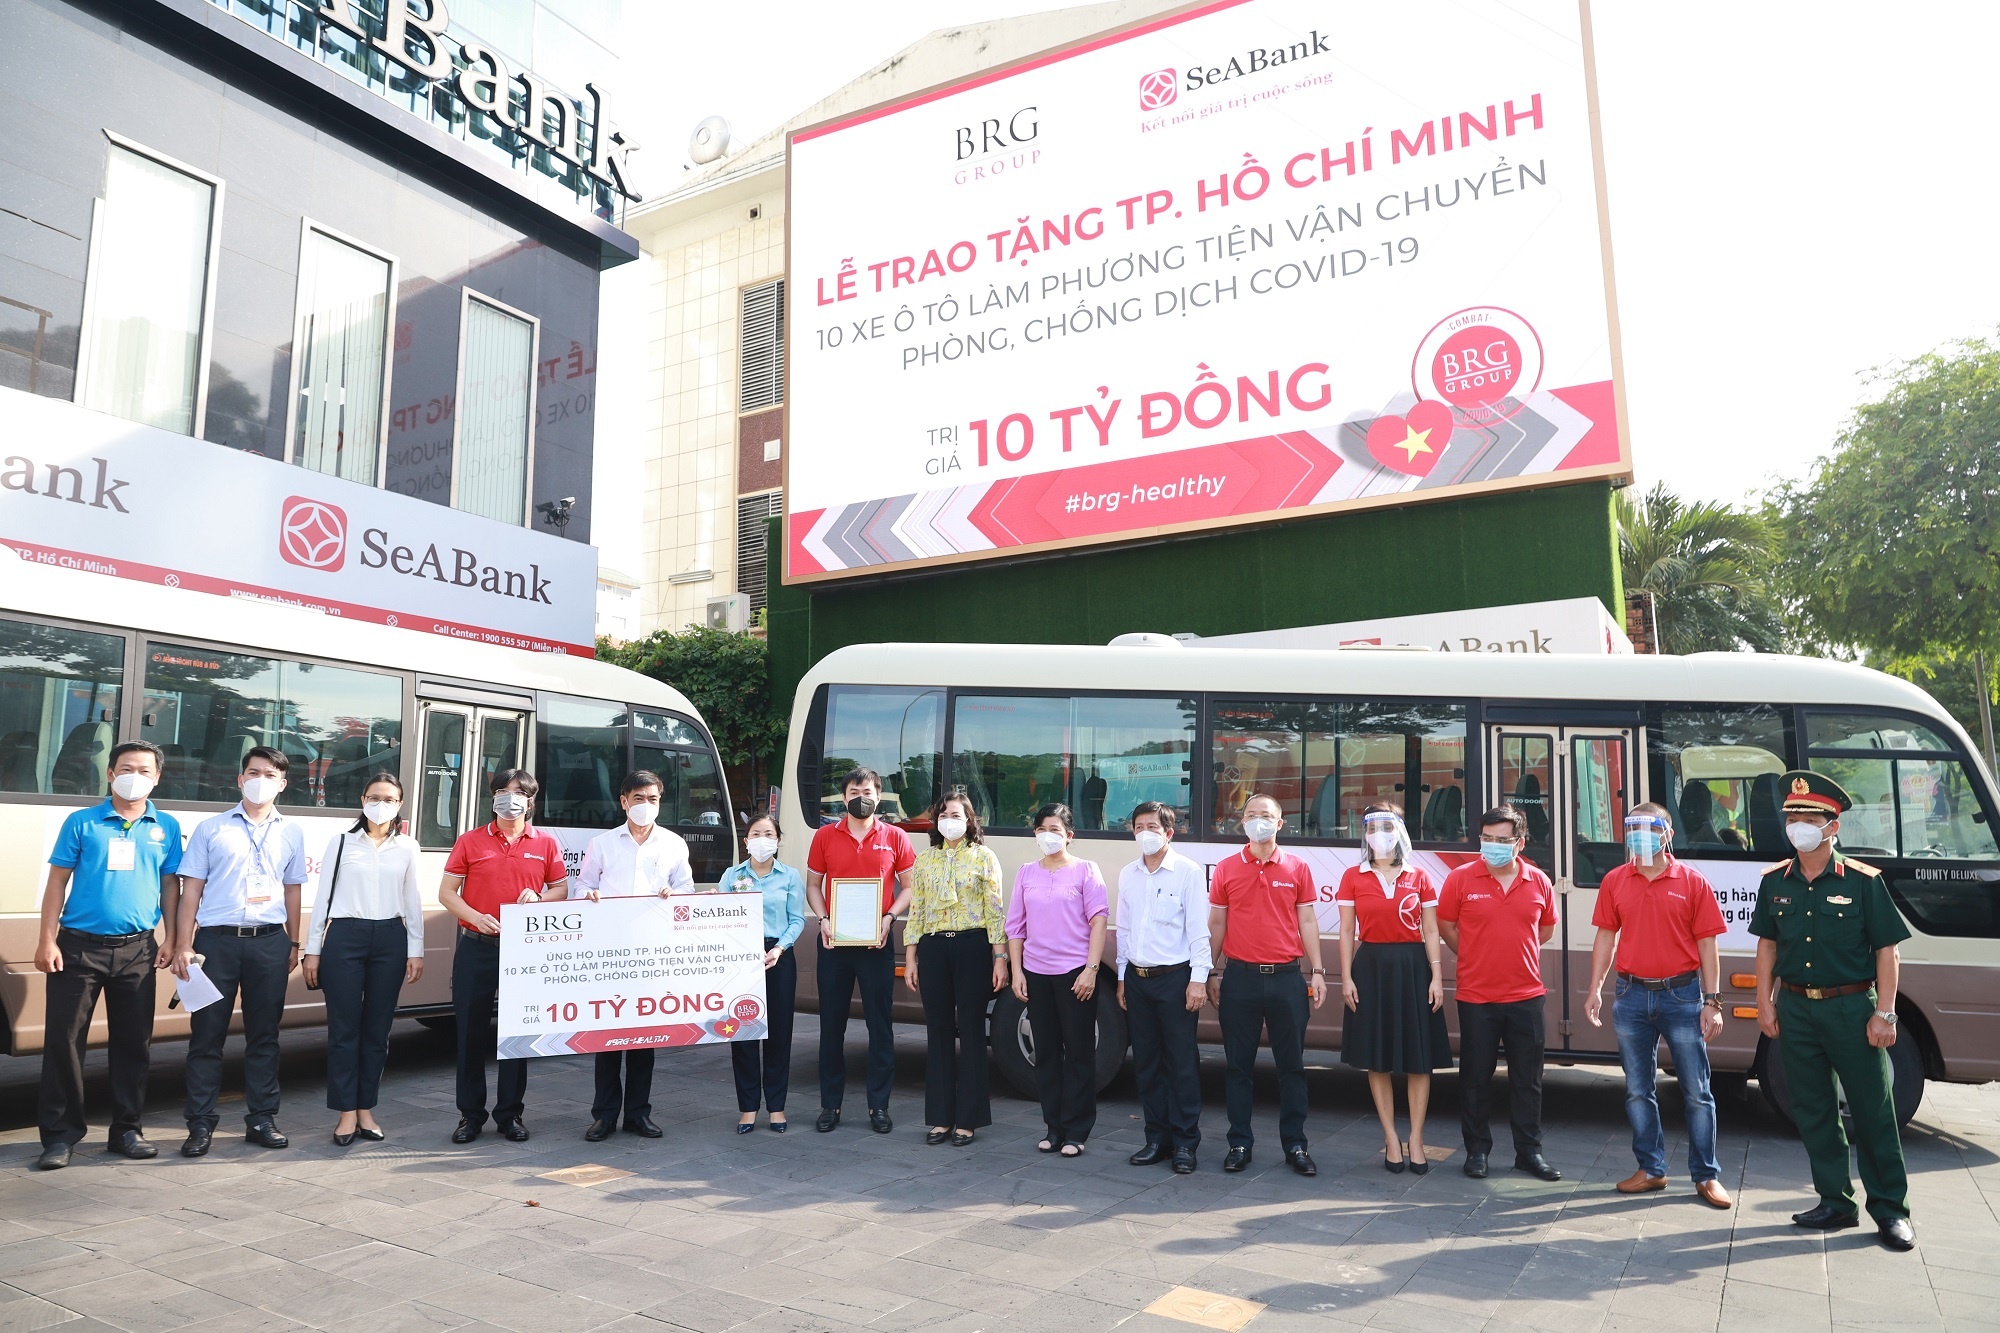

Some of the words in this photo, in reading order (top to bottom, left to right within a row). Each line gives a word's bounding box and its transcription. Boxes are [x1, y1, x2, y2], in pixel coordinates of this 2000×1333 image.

[1186, 30, 1332, 92] SeABank
[1140, 116, 1166, 133] Kết
[1172, 107, 1195, 125] nối
[1200, 101, 1223, 120] giá
[1229, 94, 1247, 109] trị
[1252, 85, 1289, 102] cuộc
[1294, 72, 1333, 91] sống
[955, 106, 1039, 161] BRG
[955, 149, 1041, 185] GROUP
[817, 257, 857, 307] LỄ
[868, 240, 977, 293] TRAO
[987, 207, 1104, 267] TẶNG
[1116, 189, 1182, 231] TP.
[1197, 152, 1270, 213] HỒ
[1284, 127, 1374, 189] CHÍ
[1391, 93, 1544, 165] MINH
[816, 326, 843, 350] 10
[852, 315, 885, 343] XE
[894, 304, 915, 332] Ô
[923, 294, 959, 326] TÔ
[969, 281, 1029, 317] LÀM
[1042, 245, 1185, 300] PHƯƠNG
[1195, 223, 1273, 263] TIỆN
[1285, 202, 1362, 243] VẬN
[1376, 156, 1546, 221] CHUYỂN
[903, 327, 1015, 370] PHÒNG,
[1024, 297, 1142, 343] CHỐNG
[1155, 275, 1237, 318] DỊCH
[1250, 237, 1419, 294] COVID-19
[1441, 340, 1509, 378] BRG
[1445, 369, 1513, 393] GROUP
[969, 412, 1034, 467] 10
[1049, 386, 1122, 453] TỶ
[1137, 361, 1332, 439] ĐỒNG
[927, 425, 958, 447] TRỊ
[925, 450, 961, 476] GIÁ
[1065, 473, 1227, 513] #brg-healthy
[37, 552, 57, 565] Hồ
[59, 556, 82, 569] Chí
[84, 560, 117, 575] Minh
[360, 528, 552, 605] SeABank
[433, 624, 449, 634] Call
[450, 627, 479, 640] Center:
[480, 633, 500, 643] 1900
[501, 636, 515, 646] 555
[516, 639, 530, 648] 587
[1138, 763, 1171, 772] SeABank
[1915, 868, 1949, 881] COUNTY
[1950, 869, 1978, 880] DELUXE
[525, 913, 583, 932] BRG
[693, 906, 748, 918] SeABank
[524, 933, 583, 944] GROUP
[597, 948, 631, 958] UBND
[635, 947, 651, 956] TP.
[697, 944, 725, 953] MINH
[504, 967, 517, 976] 10
[521, 966, 536, 975] XE
[602, 959, 655, 970] PHƯƠNG
[642, 968, 670, 979] DỊCH
[673, 966, 725, 976] COVID-19
[524, 1004, 539, 1013] TRỊ
[546, 1002, 578, 1022] 10
[588, 994, 627, 1019] TỶ
[636, 991, 725, 1016] ĐỒNG
[737, 1003, 756, 1013] BRG
[522, 1014, 540, 1024] GIÁ
